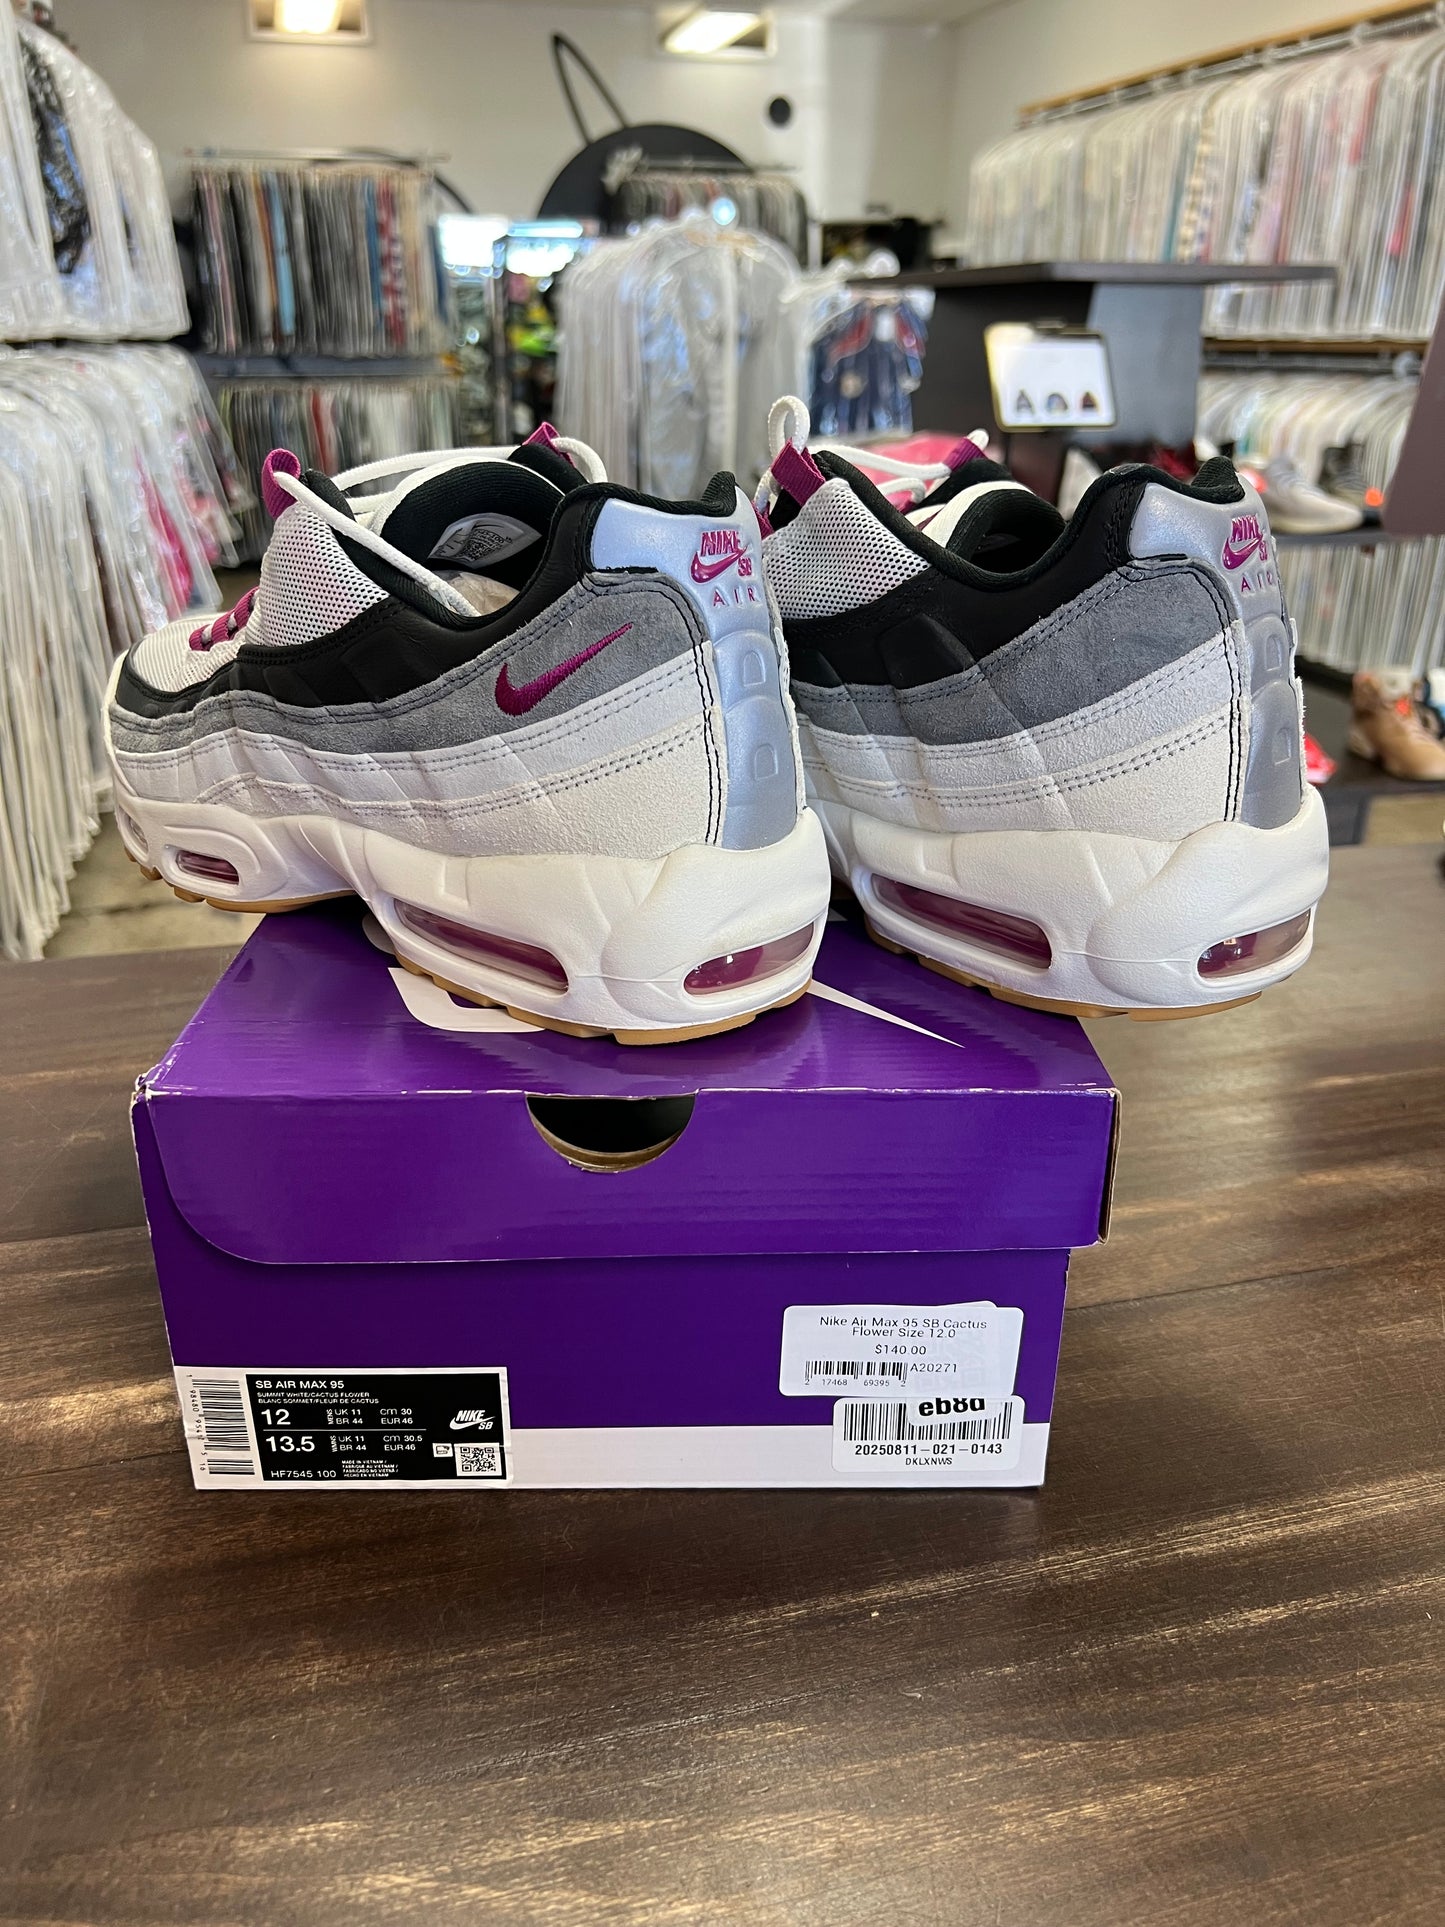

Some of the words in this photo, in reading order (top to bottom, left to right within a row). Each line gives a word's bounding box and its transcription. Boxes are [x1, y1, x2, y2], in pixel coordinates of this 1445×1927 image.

[700, 530, 741, 557] NIKE
[712, 586, 757, 606] AIR
[820, 1316, 848, 1326] Nike
[851, 1316, 867, 1327] Air
[872, 1317, 898, 1327] Max
[902, 1318, 918, 1328] 95
[922, 1318, 940, 1328] SB
[943, 1318, 987, 1329] Cactus
[852, 1327, 894, 1337] Flower
[898, 1327, 924, 1338] Size
[930, 1329, 956, 1338] 12.0
[875, 1344, 927, 1355] $140.00
[910, 1363, 957, 1373] A20271
[255, 1380, 273, 1389] SB
[275, 1380, 296, 1389] AIR
[300, 1380, 327, 1389] MAX
[330, 1380, 344, 1389] 95
[863, 1379, 890, 1387] 69395
[261, 1408, 291, 1425] 12
[326, 1409, 334, 1425] MENS
[400, 1408, 412, 1416] 30
[455, 1410, 486, 1421] NIKE
[336, 1417, 350, 1425] BR
[352, 1417, 363, 1425] 44
[381, 1417, 401, 1425] EUR
[401, 1417, 413, 1425] 46
[478, 1421, 494, 1430] SB
[265, 1435, 316, 1452] 13.5
[905, 1457, 953, 1465] DKLXNWS
[271, 1470, 314, 1478] HF7545
[317, 1470, 337, 1478] 100
